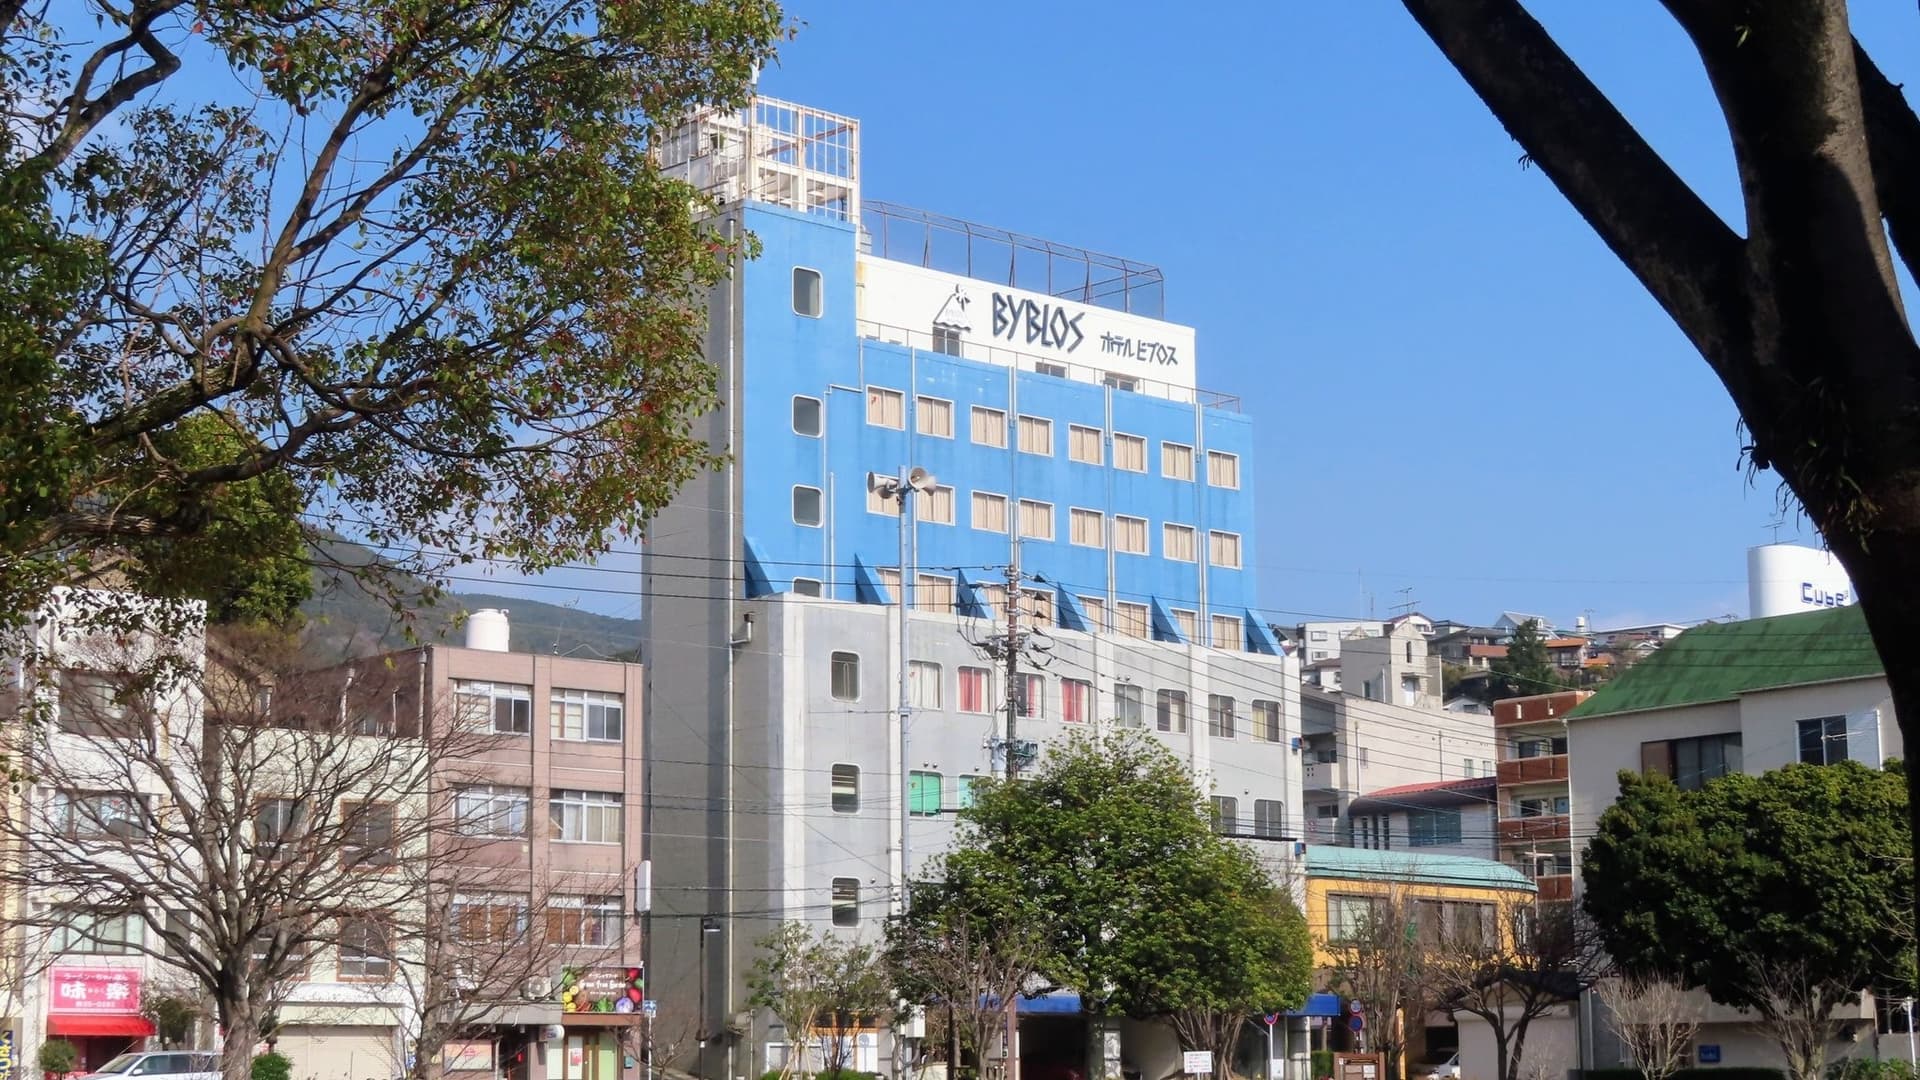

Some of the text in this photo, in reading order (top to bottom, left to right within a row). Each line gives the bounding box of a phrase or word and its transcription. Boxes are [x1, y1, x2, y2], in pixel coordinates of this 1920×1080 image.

[992, 292, 1085, 353] BYBLOS
[1100, 331, 1135, 358] ホテル
[1802, 582, 1844, 607] Cube
